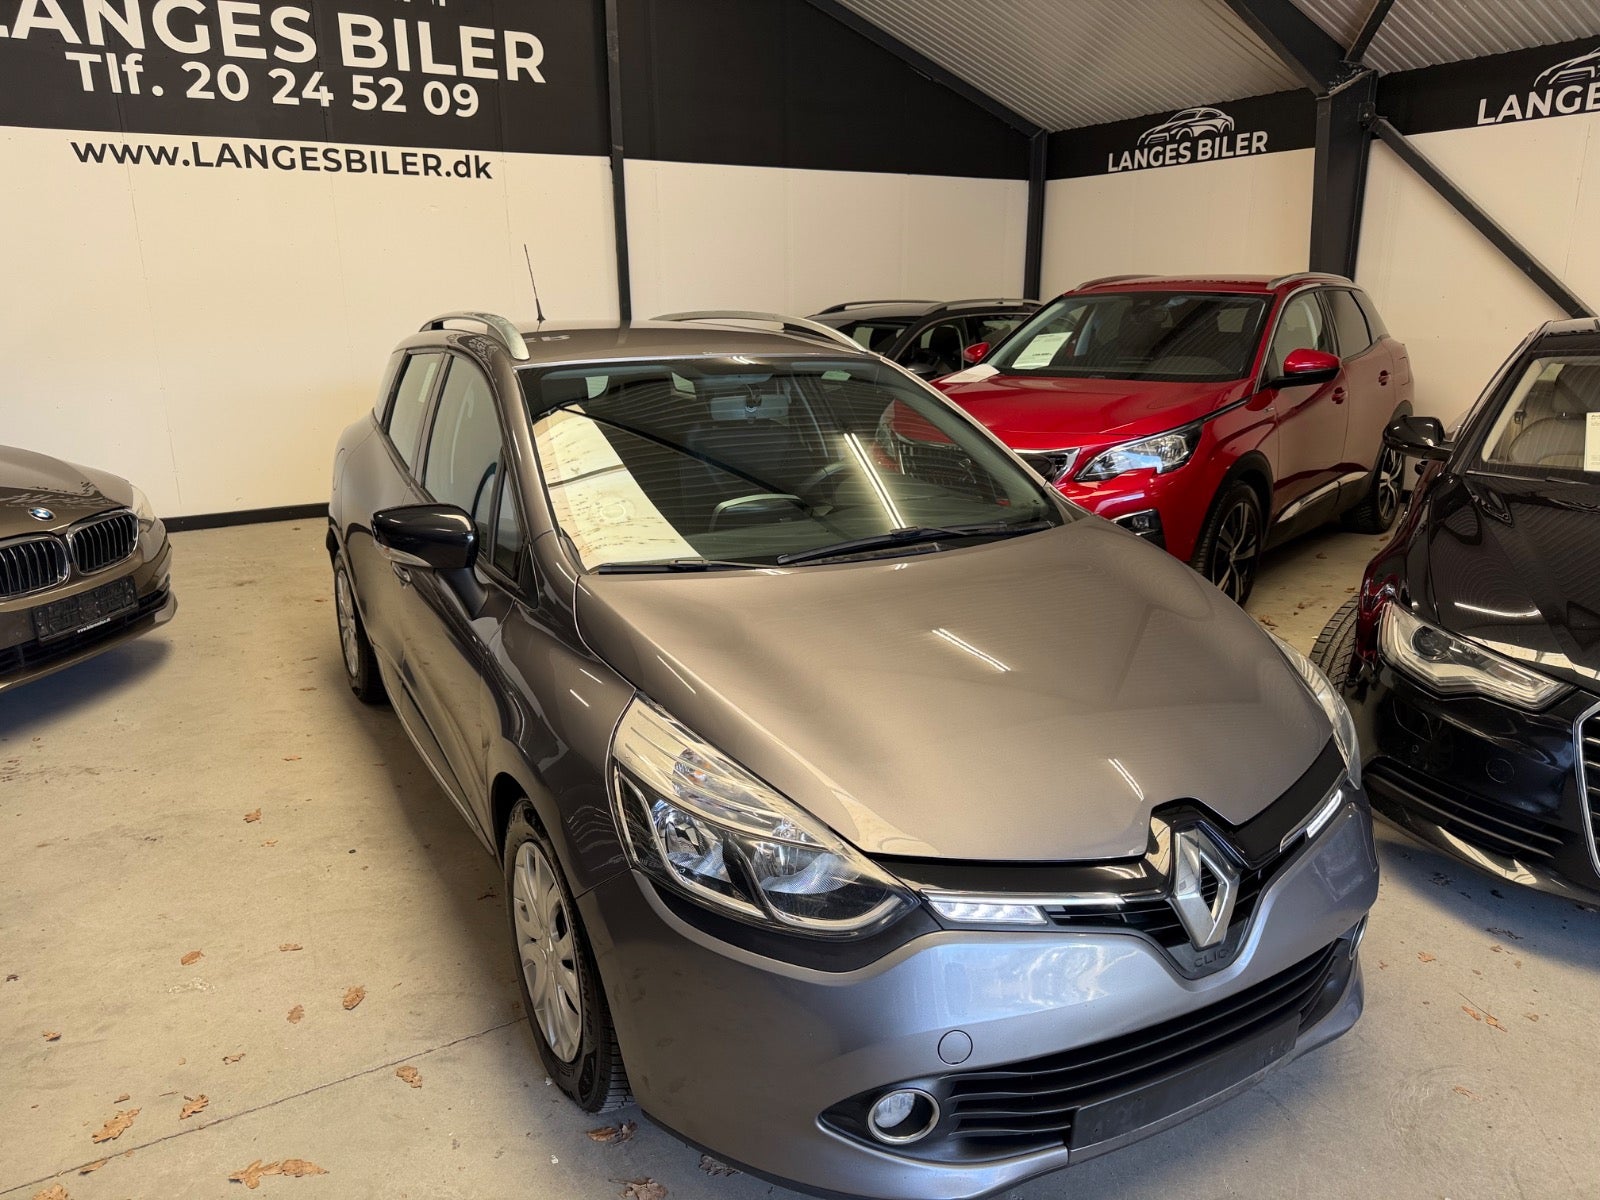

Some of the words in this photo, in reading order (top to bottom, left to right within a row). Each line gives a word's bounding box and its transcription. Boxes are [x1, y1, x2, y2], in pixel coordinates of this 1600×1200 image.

[0, 0, 317, 63] ANGES
[337, 12, 546, 84] BILER
[65, 52, 164, 97] Tlf.
[182, 61, 250, 102] 20
[268, 67, 335, 108] 24
[351, 74, 407, 113] 52
[422, 80, 479, 118] 09
[70, 141, 493, 180] www.LANGESBILER.dk
[1108, 141, 1192, 173] LANGES
[1197, 130, 1269, 161] BILER
